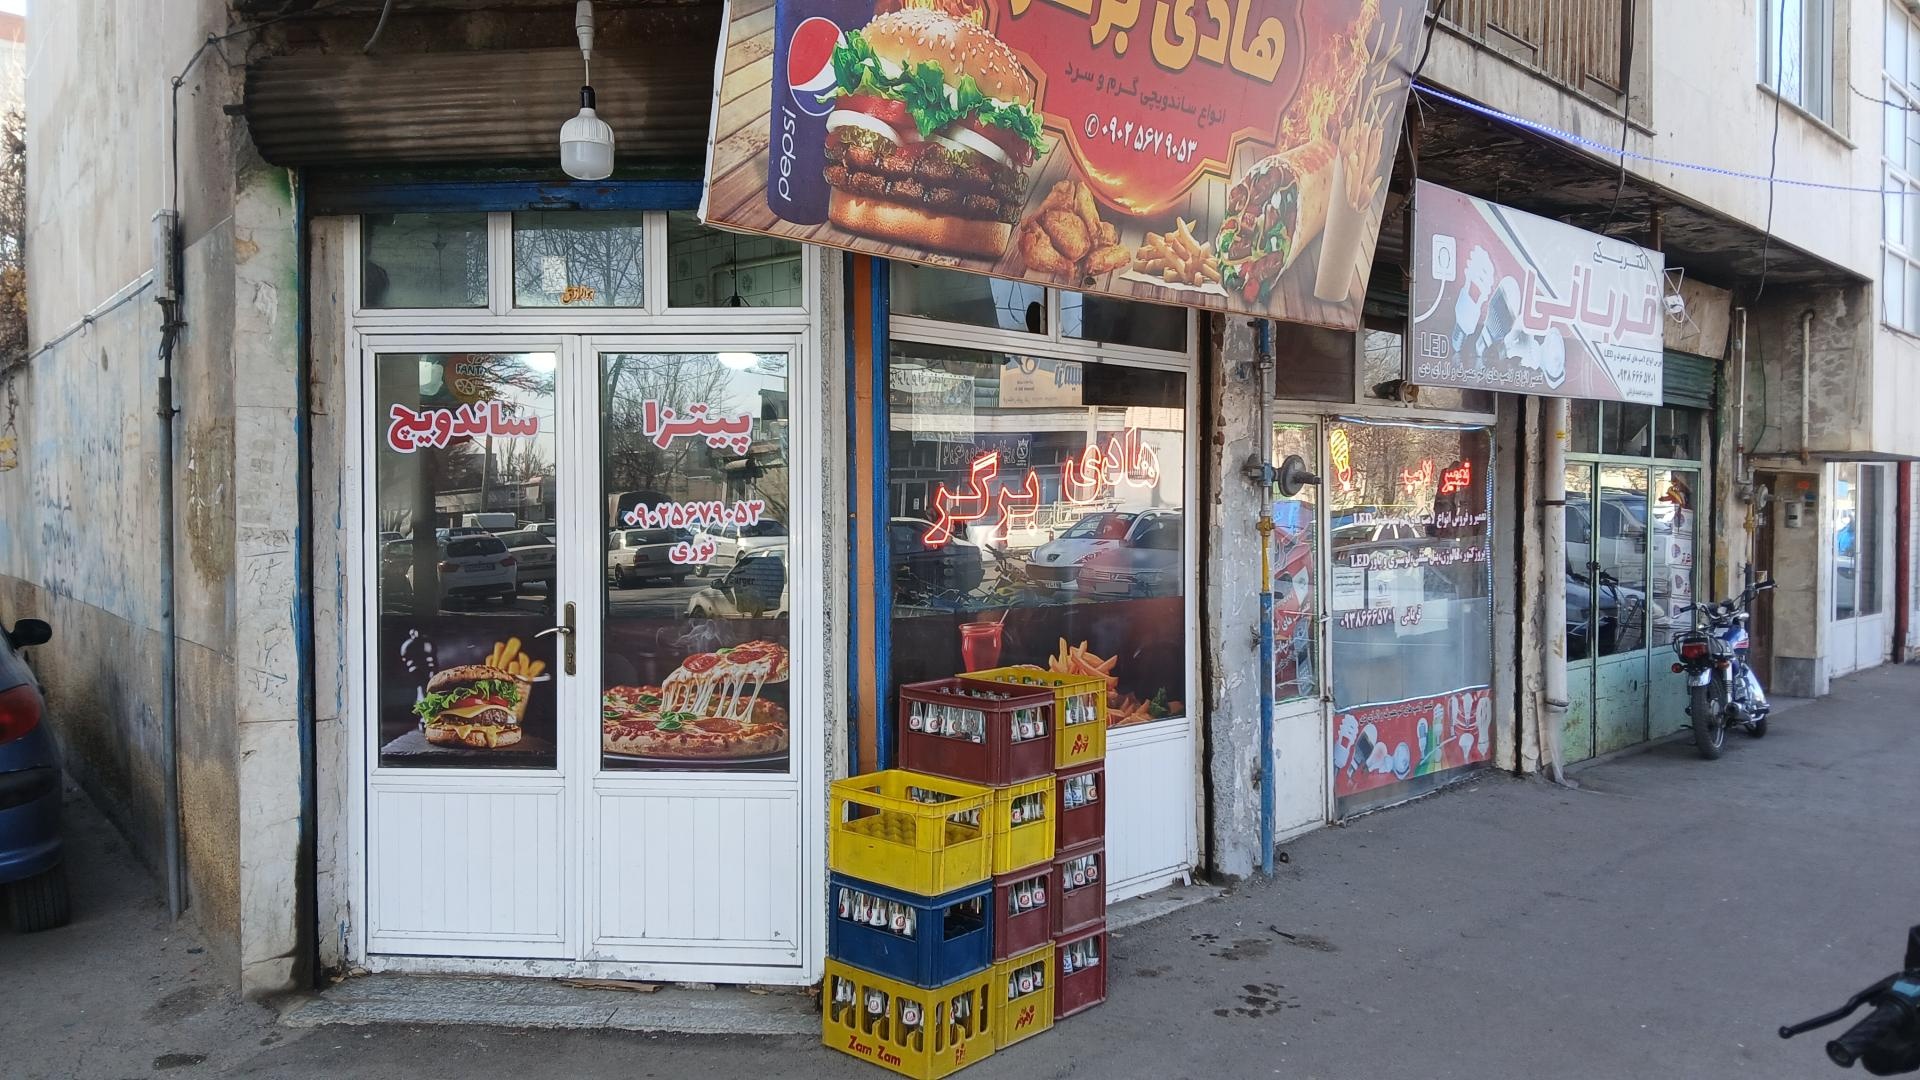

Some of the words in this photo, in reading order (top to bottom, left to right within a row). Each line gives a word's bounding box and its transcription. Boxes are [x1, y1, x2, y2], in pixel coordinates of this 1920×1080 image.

[1151, 0, 1286, 83] هادی
[1064, 61, 1095, 83] سرد
[1096, 78, 1105, 91] و
[1107, 77, 1139, 97] گرم
[1139, 87, 1198, 116] ساندویچی
[1197, 107, 1227, 129] انواع
[778, 105, 797, 202] pepsi
[1593, 240, 1649, 271] الکتریک
[1523, 264, 1658, 343] قربانی
[1420, 331, 1450, 359] LED
[387, 400, 540, 453] ساندویچ
[642, 400, 754, 456] پیتزا
[1063, 425, 1160, 505] هادی
[1441, 461, 1471, 494] تعمیر
[924, 451, 1040, 547] برگر
[624, 500, 765, 530] ۰۹۰۲۵۶۷۹۰۵۳
[1353, 512, 1373, 525] LED
[1436, 510, 1452, 529] انواع
[1468, 514, 1473, 526] و
[668, 536, 717, 565] نوری
[1351, 554, 1370, 568] LED
[1340, 608, 1396, 630] ۰۹۳۸۶۶۶۵۷۰۱
[1401, 604, 1423, 627] قربانی
[848, 1034, 873, 1056] Zam
[877, 1044, 902, 1067] Zam
